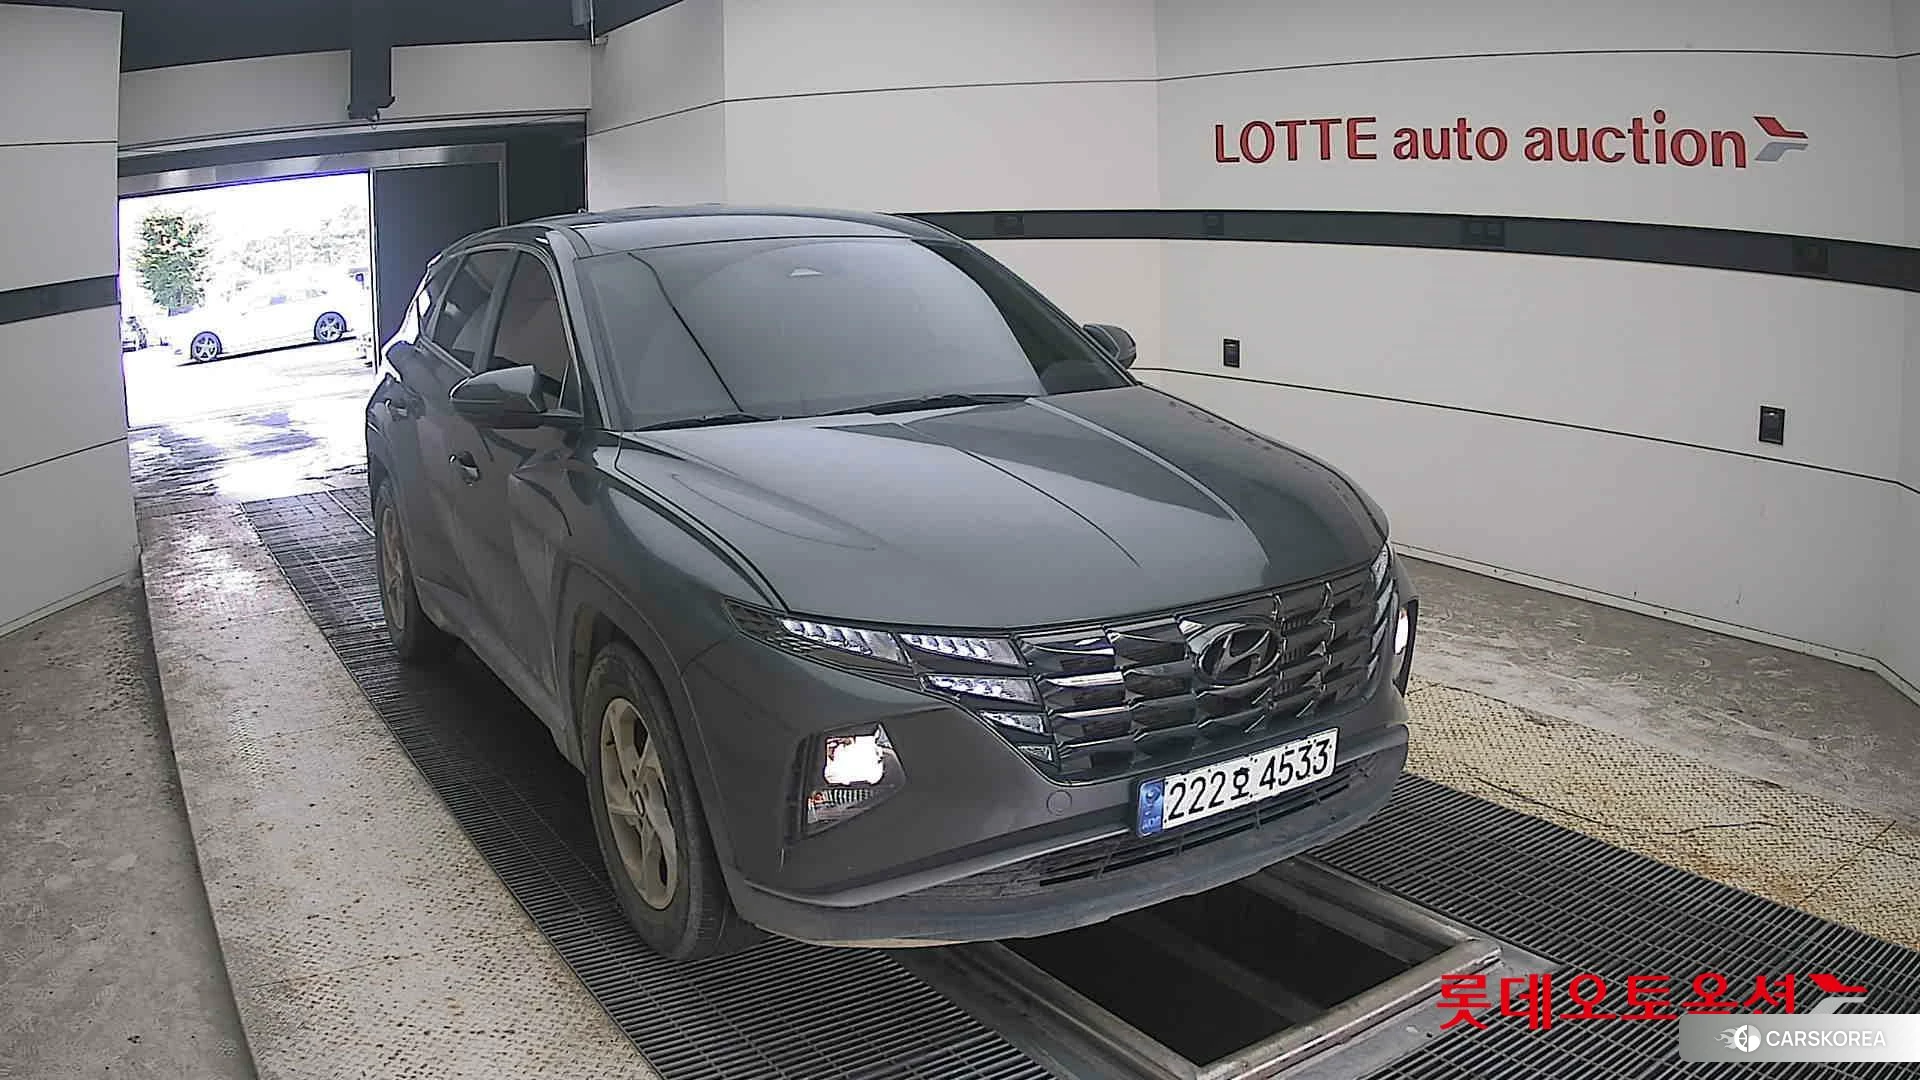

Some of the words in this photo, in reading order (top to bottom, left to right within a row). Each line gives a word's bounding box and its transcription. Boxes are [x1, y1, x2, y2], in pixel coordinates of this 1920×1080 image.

[1214, 116, 1377, 163] LOTTE
[1393, 117, 1508, 162] auto
[1524, 109, 1747, 169] auction
[1259, 738, 1331, 791] 4533
